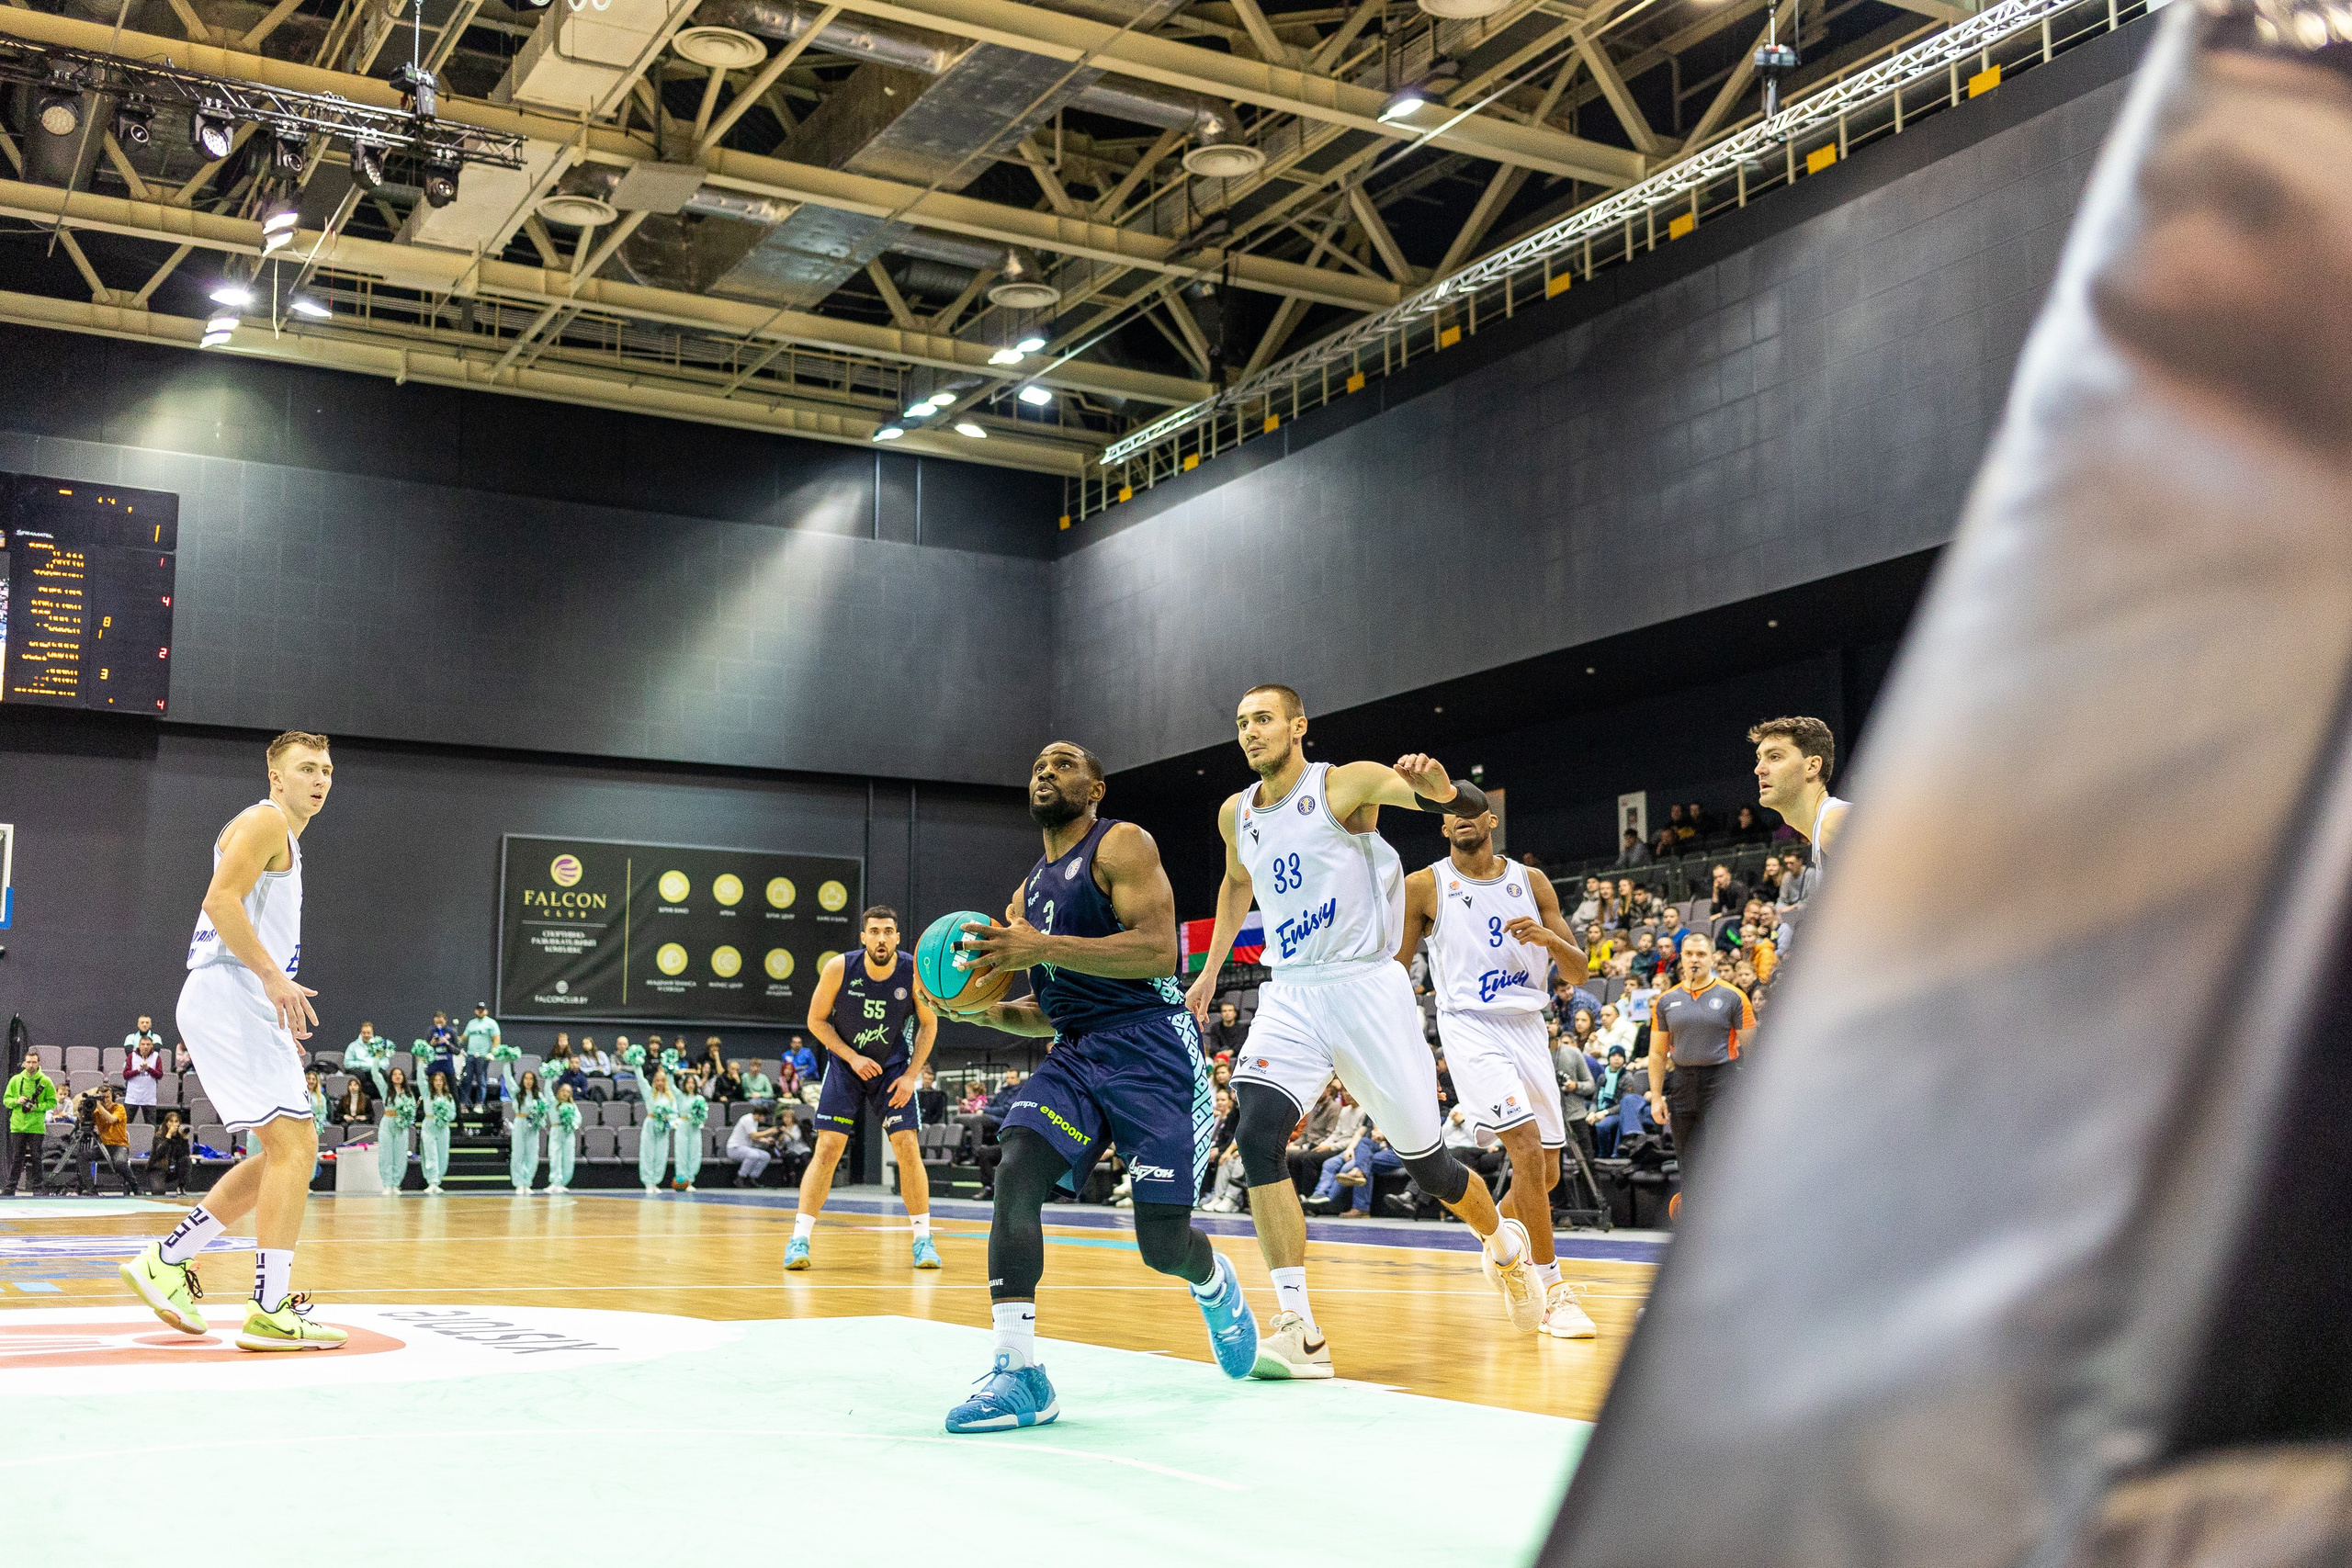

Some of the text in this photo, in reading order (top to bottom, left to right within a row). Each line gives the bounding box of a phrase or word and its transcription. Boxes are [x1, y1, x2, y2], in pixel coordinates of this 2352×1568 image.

[162, 596, 171, 607] 4
[102, 615, 112, 627] 8
[158, 647, 168, 659] 2
[99, 668, 109, 680] 3
[156, 699, 165, 710] 4
[1273, 852, 1303, 894] 33
[524, 889, 607, 908] FALCON
[1488, 916, 1504, 948] 3
[863, 998, 887, 1020] 55
[1039, 1105, 1091, 1145] евроопт
